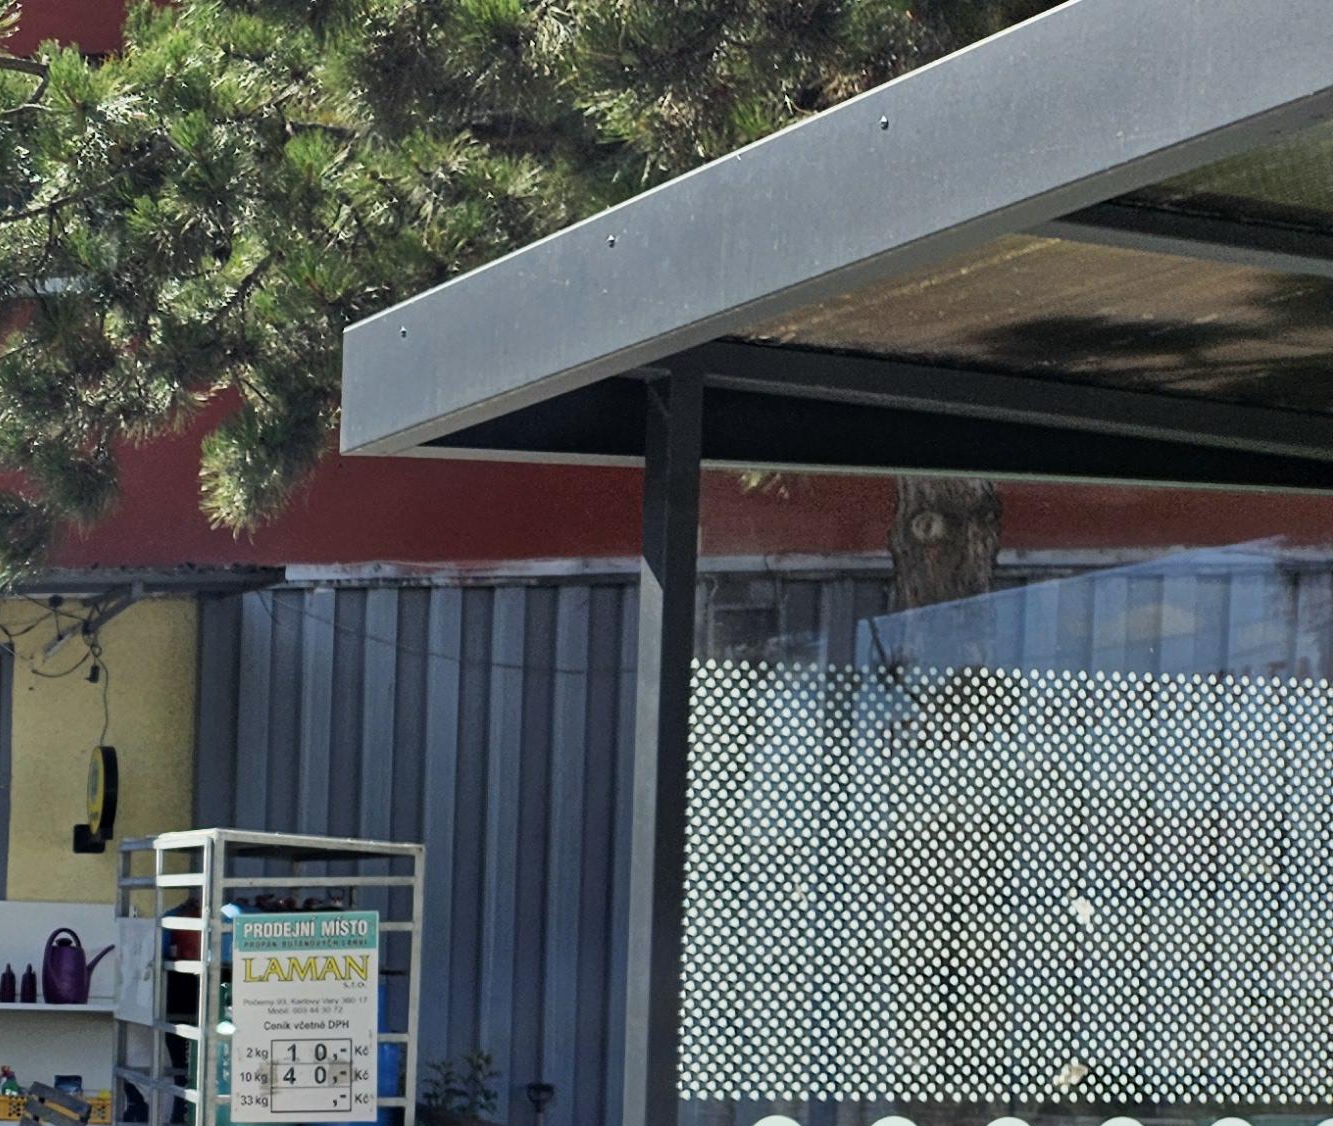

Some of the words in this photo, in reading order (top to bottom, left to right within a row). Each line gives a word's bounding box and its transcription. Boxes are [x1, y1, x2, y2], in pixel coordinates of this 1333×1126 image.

[244, 917, 316, 938] PRODEJNÍ
[321, 916, 368, 937] MÍSTO
[241, 954, 370, 982] LAMAN
[328, 1020, 349, 1029] DPH
[246, 1048, 253, 1057] 2
[255, 1048, 269, 1060] kg
[354, 1046, 369, 1056] Kč
[240, 1072, 253, 1082] 10
[254, 1072, 268, 1084] kg
[354, 1070, 369, 1081] Kč
[241, 1095, 253, 1106] 33
[255, 1095, 269, 1107] kg
[354, 1094, 369, 1104] Kč
